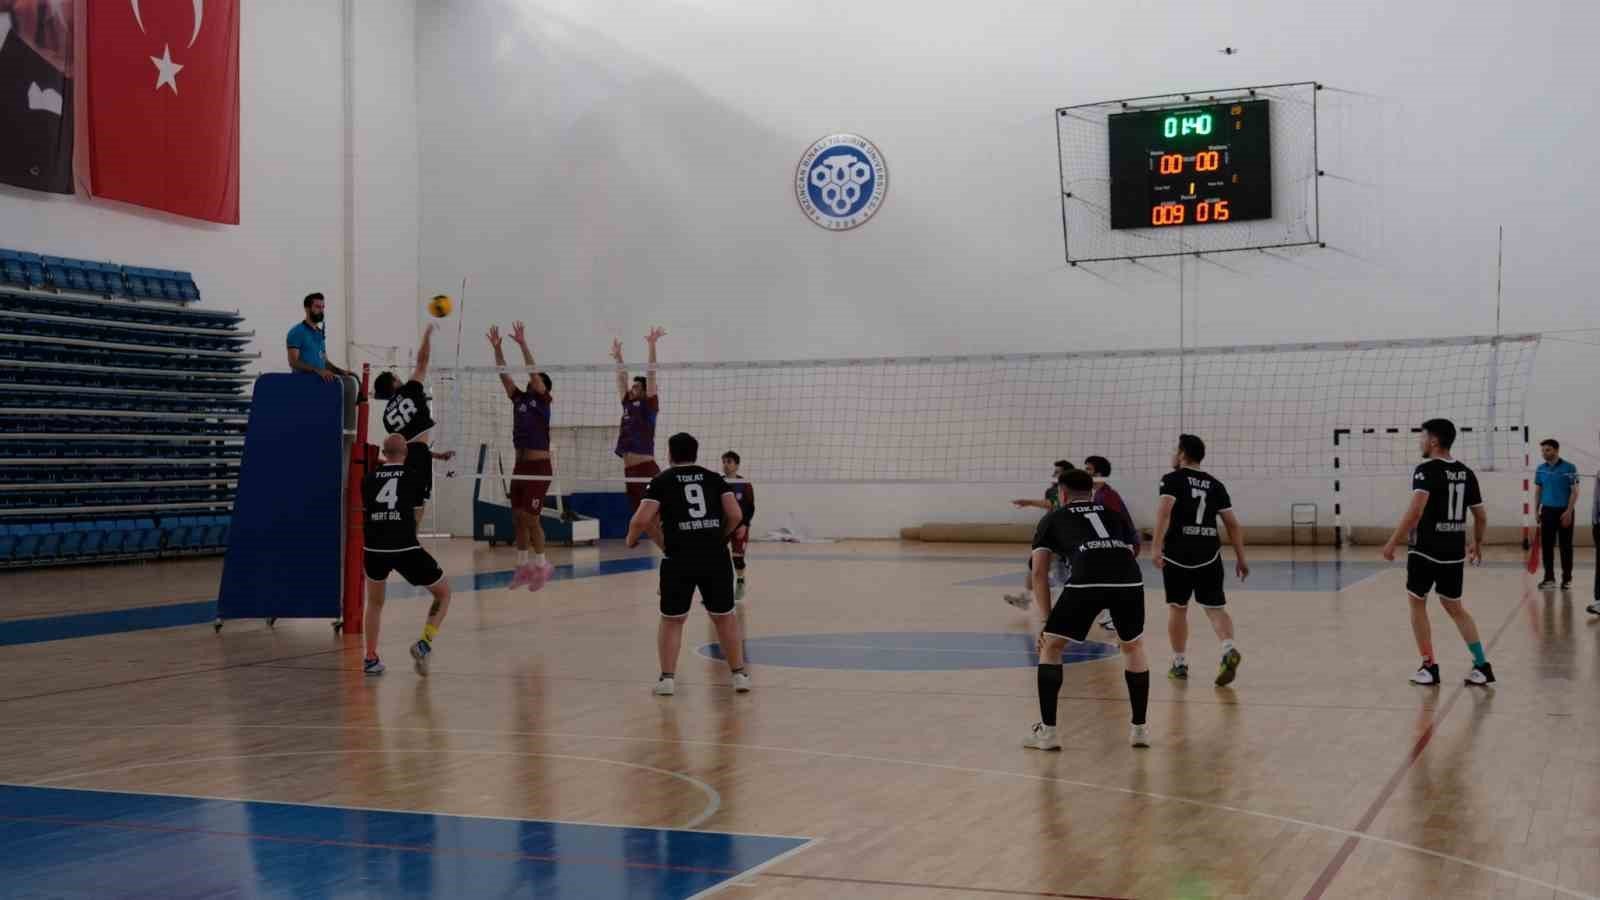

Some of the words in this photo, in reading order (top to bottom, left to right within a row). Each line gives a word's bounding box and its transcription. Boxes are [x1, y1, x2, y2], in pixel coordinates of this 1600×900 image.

[1160, 154, 1183, 175] 00
[1195, 151, 1219, 172] 00
[1152, 204, 1185, 226] 009
[1196, 201, 1230, 223] 015
[375, 470, 405, 478] TOKAT
[375, 477, 399, 510] 4
[684, 483, 707, 518] 9
[1191, 488, 1207, 525] 7
[1447, 483, 1465, 520] 11
[1083, 512, 1110, 539] 1
